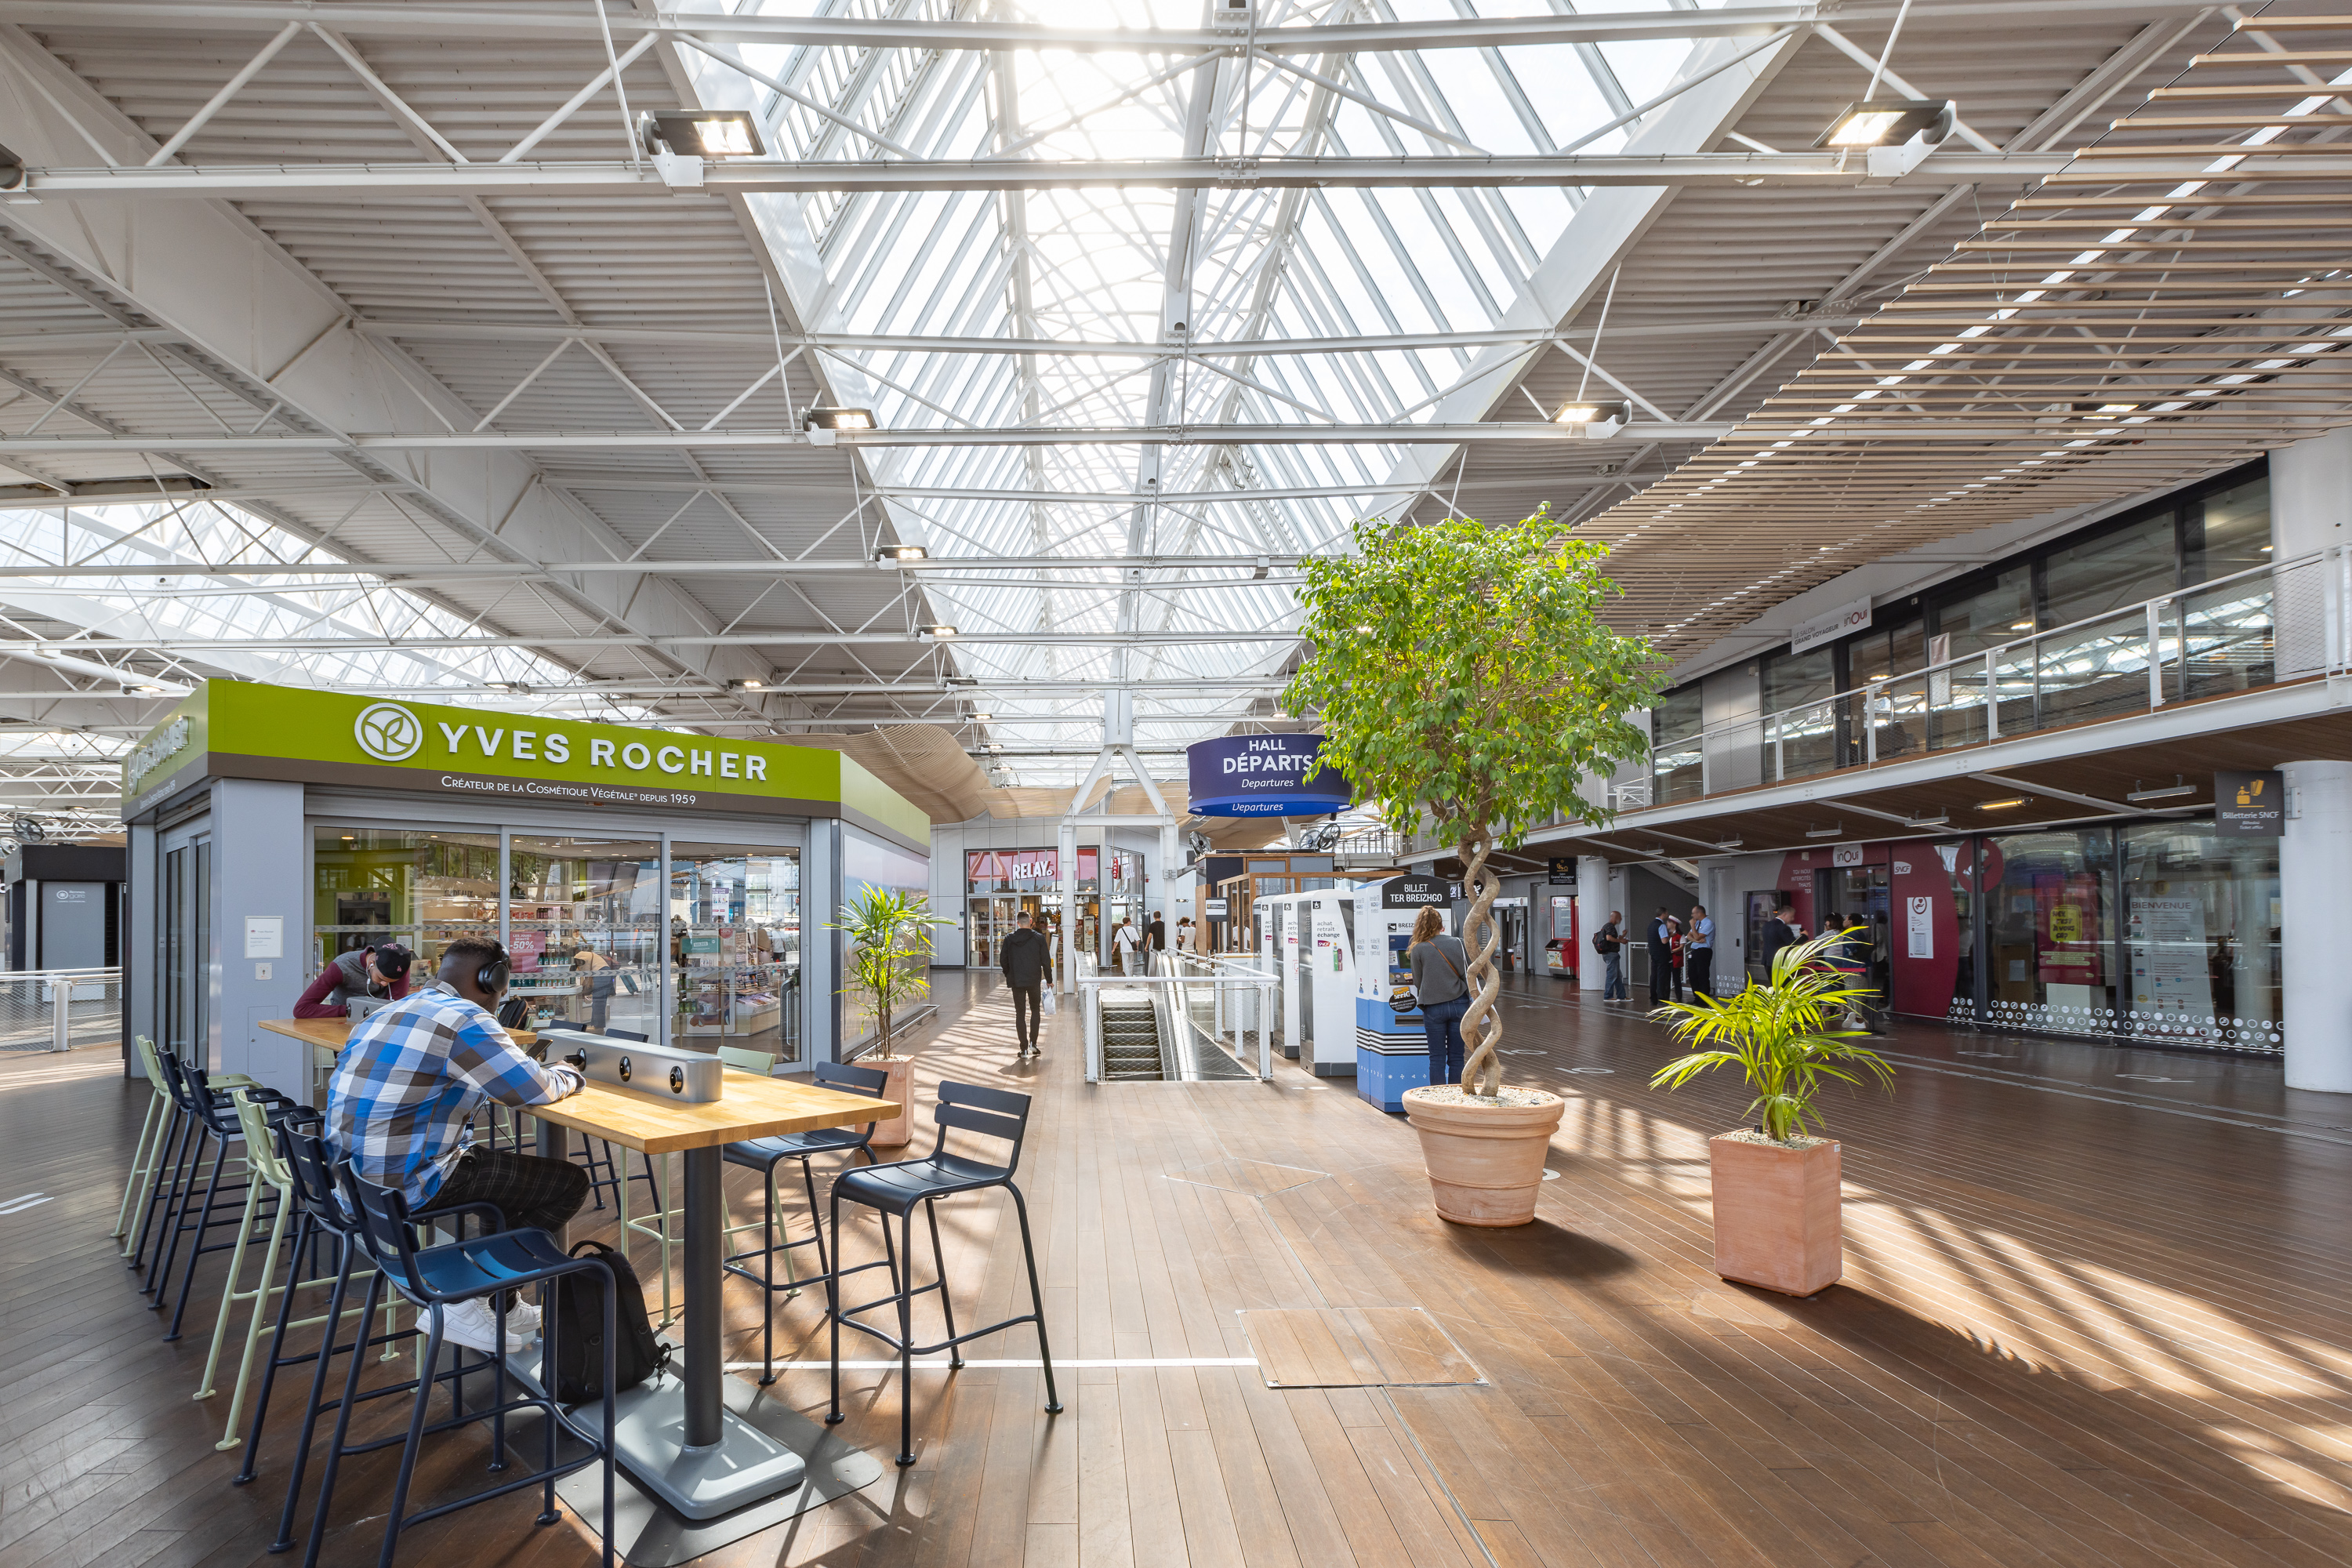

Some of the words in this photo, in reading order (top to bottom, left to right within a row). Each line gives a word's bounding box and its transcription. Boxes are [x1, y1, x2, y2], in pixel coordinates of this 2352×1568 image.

[1795, 634, 1811, 645] GRAND
[1812, 623, 1839, 639] VOYAGEUR
[1800, 626, 1816, 637] SALON
[1249, 739, 1287, 752] HALL
[437, 722, 570, 764] YVES
[590, 739, 767, 781] ROCHER
[1223, 752, 1313, 774] DÉPARTS
[1241, 779, 1294, 789] Departures
[670, 793, 696, 805] 1959
[1232, 803, 1283, 813] Departures
[1012, 860, 1050, 880] RELAY
[1404, 884, 1428, 892] BILLET
[1390, 894, 1404, 902] TER
[1406, 894, 1443, 902] BREIZHGO
[510, 940, 535, 949] -50%
